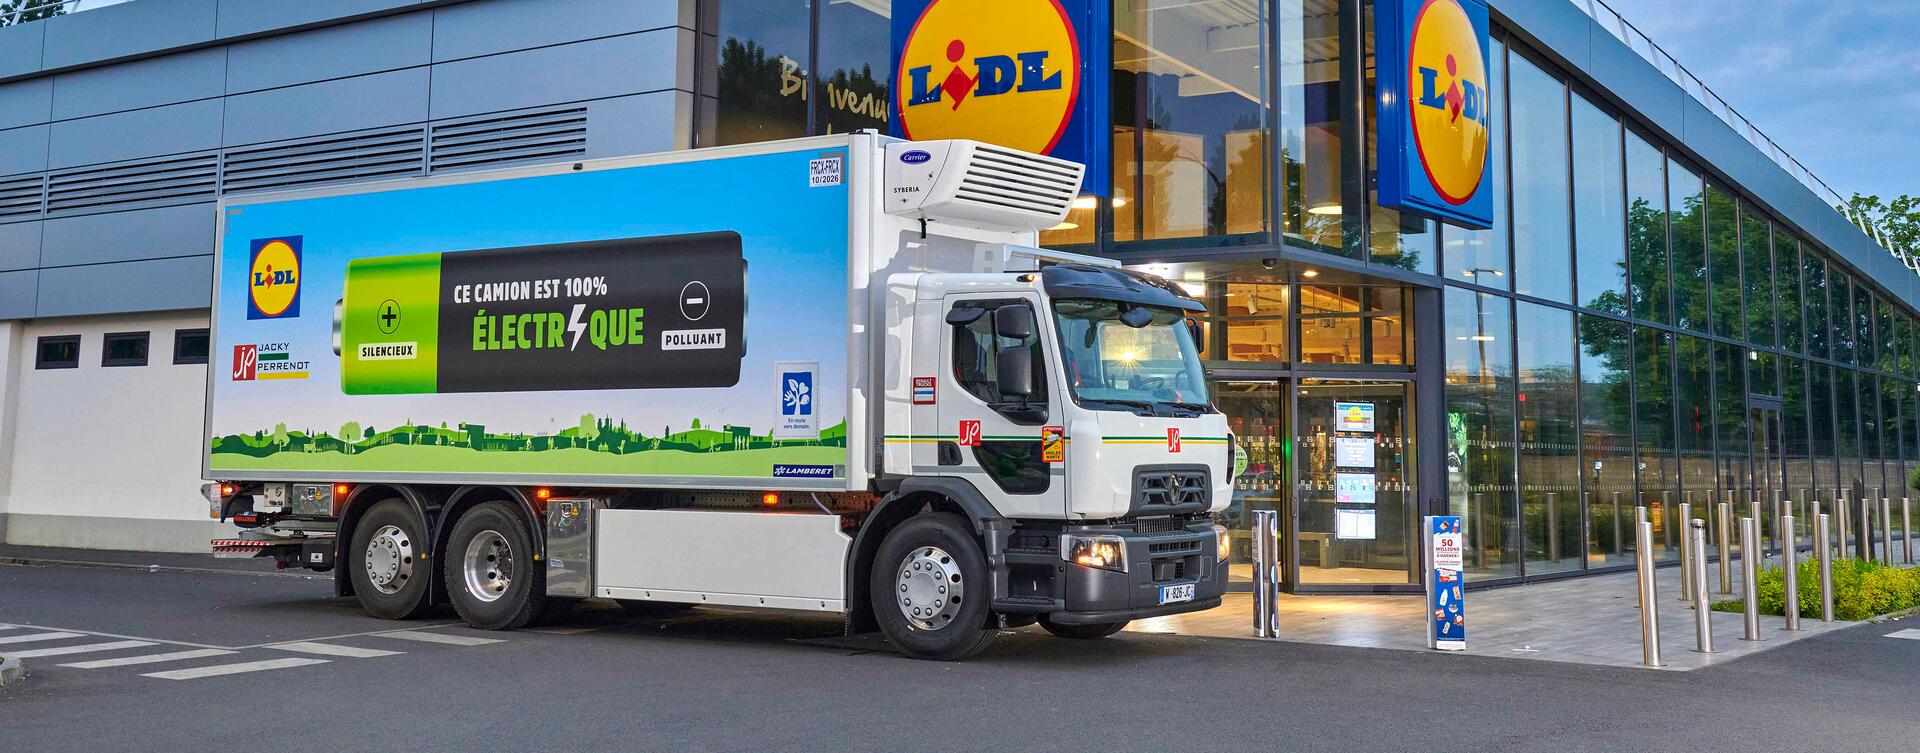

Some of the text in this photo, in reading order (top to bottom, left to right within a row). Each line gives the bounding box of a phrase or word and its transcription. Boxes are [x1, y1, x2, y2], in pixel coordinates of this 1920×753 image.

[903, 153, 927, 162] Carrier
[811, 175, 839, 184] 10/2026
[893, 186, 920, 194] SYBERIA
[453, 276, 608, 303] CE CAMION EST 100%
[665, 332, 722, 346] POLLUANT
[258, 343, 290, 351] JACKY
[362, 345, 413, 357] SILENCIEUX
[257, 361, 310, 371] PERRENOT
[785, 465, 833, 475] LAMBERET
